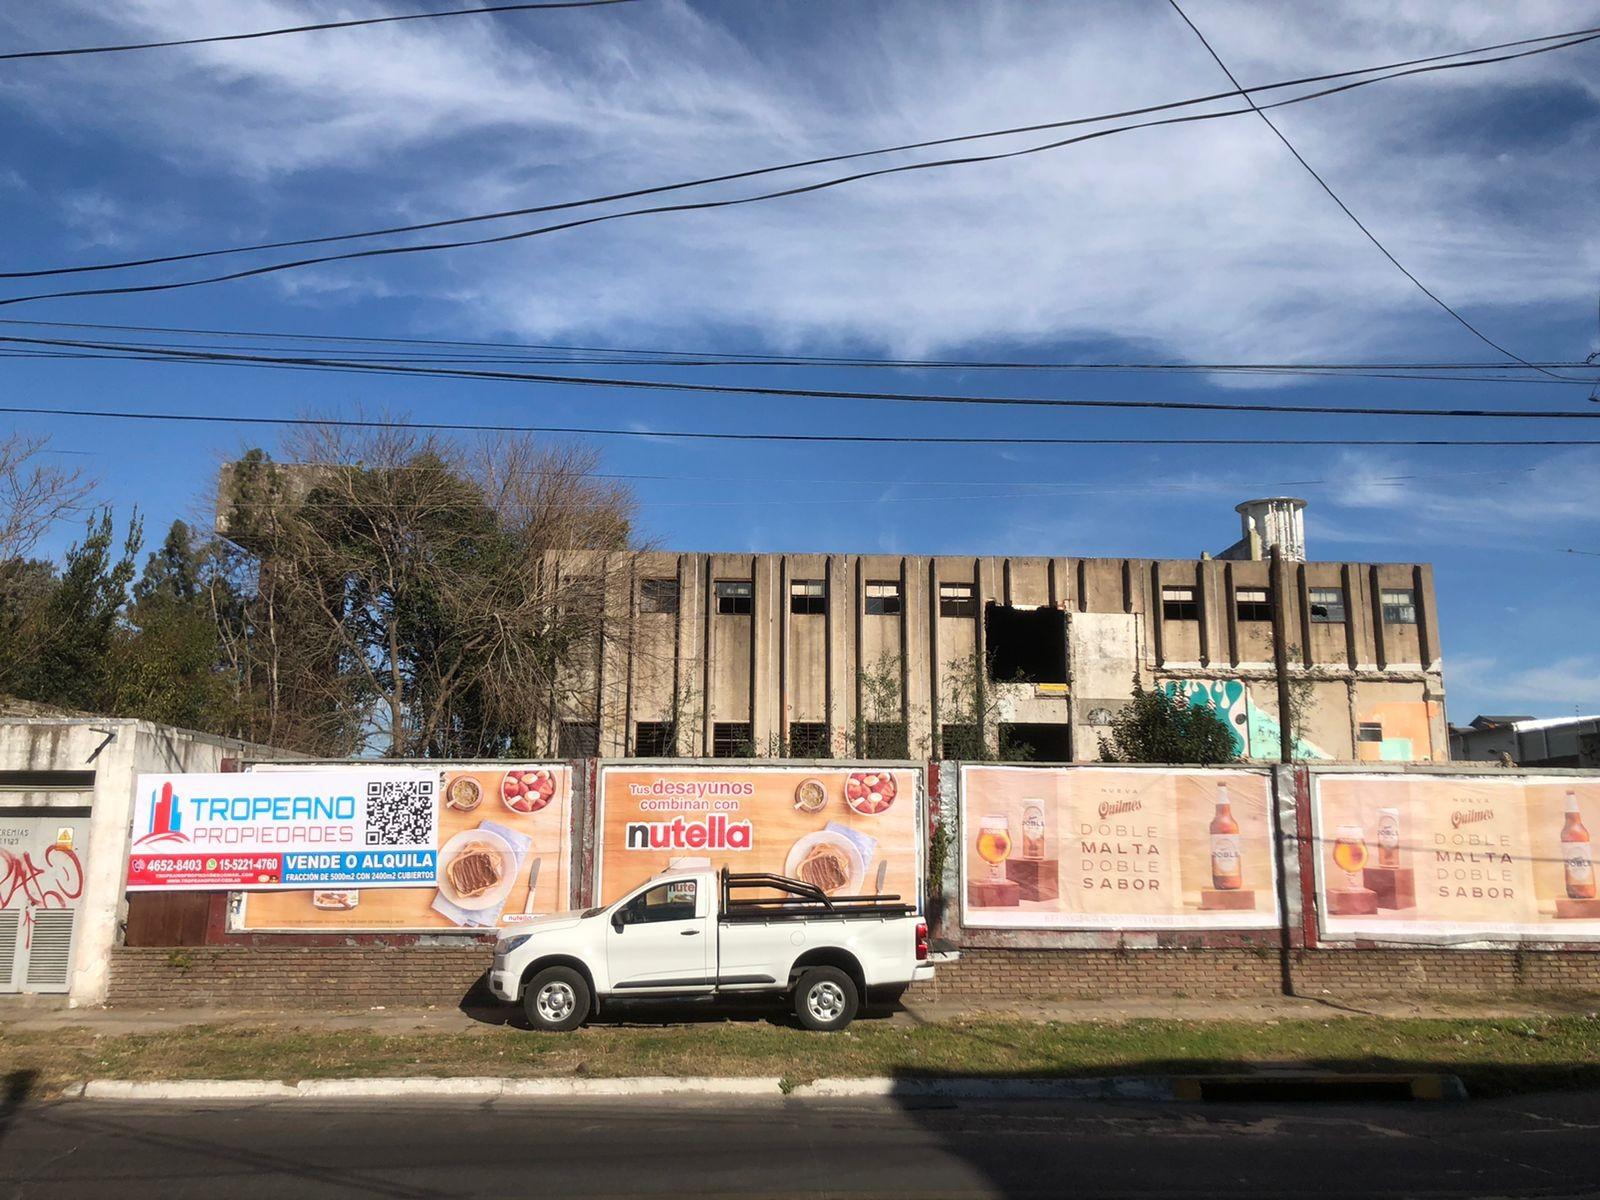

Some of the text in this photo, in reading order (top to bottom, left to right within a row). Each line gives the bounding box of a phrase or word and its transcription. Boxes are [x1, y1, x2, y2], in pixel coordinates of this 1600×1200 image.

[630, 779, 753, 797] Tus desayunos
[190, 796, 355, 821] TROPEANO
[640, 797, 738, 811] combinan con
[1098, 799, 1142, 820] Quilmes
[1451, 809, 1494, 829] Quilmes
[193, 825, 353, 843] PROPIEDADES
[628, 816, 750, 848] nutella
[1081, 823, 1158, 838] DOBLE
[1434, 833, 1511, 847] DOBLE
[1082, 842, 1160, 855] MALTA
[286, 853, 434, 869] VENDE O ALQUILA
[1436, 850, 1513, 864] MALTA
[147, 858, 202, 872] 4652-8403
[219, 858, 278, 871] 15-5221-4760
[1082, 861, 1158, 872] DOBLE
[397, 871, 435, 880] CUBIERTOS
[1437, 868, 1512, 881] DOBLE
[1084, 878, 1160, 890] SABOR
[1439, 886, 1514, 898] SABOR
